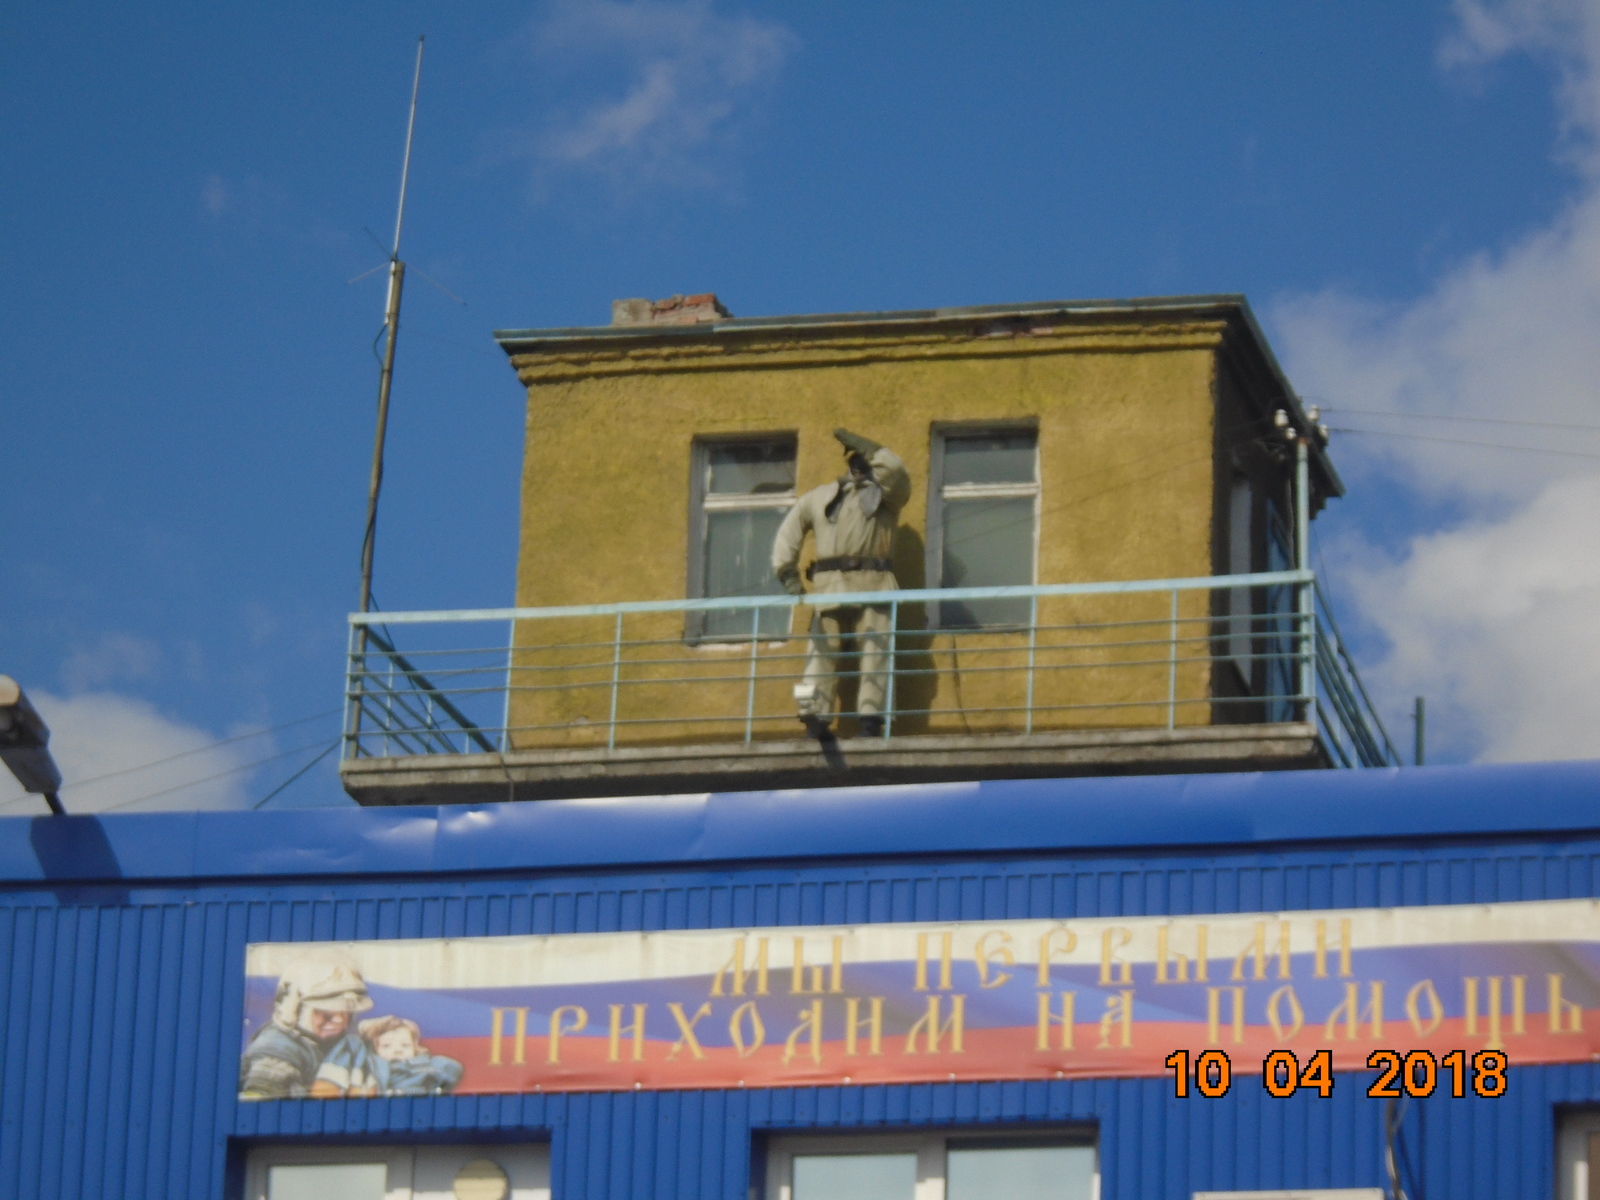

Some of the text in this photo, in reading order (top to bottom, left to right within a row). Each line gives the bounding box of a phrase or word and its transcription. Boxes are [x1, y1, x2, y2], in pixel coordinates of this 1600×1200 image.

[709, 934, 844, 997] МЫ
[1036, 988, 1136, 1051] НА
[1206, 972, 1584, 1051] ПОМОЩЬ
